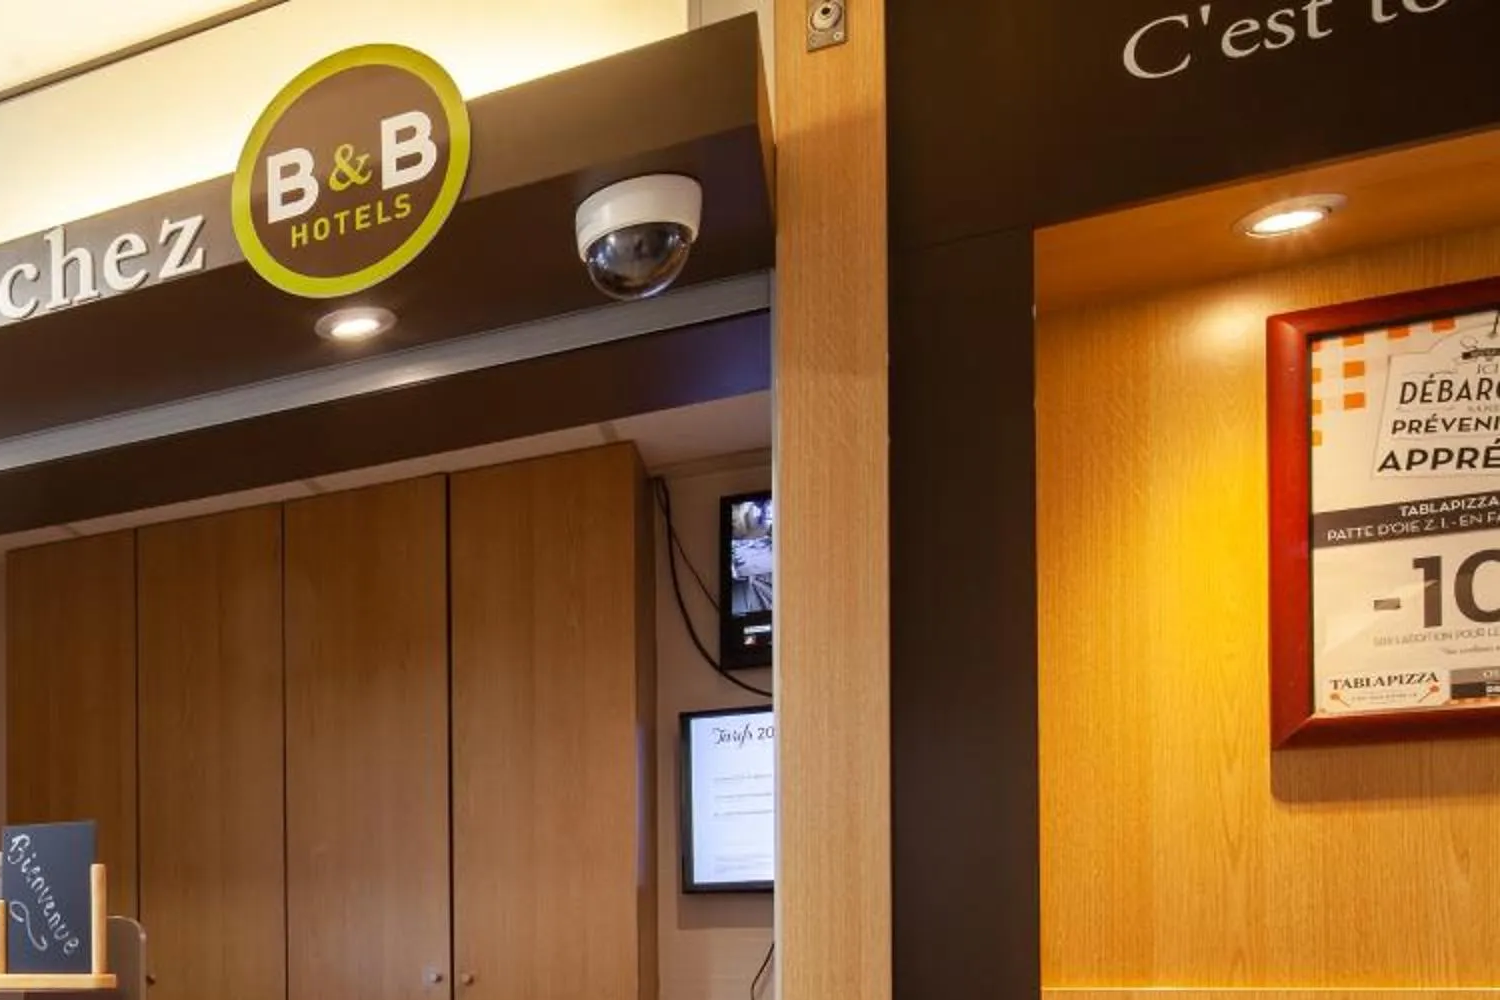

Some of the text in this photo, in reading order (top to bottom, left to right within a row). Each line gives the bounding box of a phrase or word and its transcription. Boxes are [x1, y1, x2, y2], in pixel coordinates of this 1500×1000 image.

[1123, 0, 1333, 79] C'est
[290, 193, 413, 249] HOTELS
[1399, 372, 1500, 405] DÉBAR
[1377, 438, 1500, 473] APPRÉ
[1400, 495, 1499, 518] TABLAPIZZA
[1327, 525, 1375, 541] PATTE
[1377, 520, 1421, 537] D'OIE
[1459, 512, 1483, 527] EN
[1330, 671, 1440, 691] TABLAPIZZA
[7, 833, 80, 956] Bienvenue
